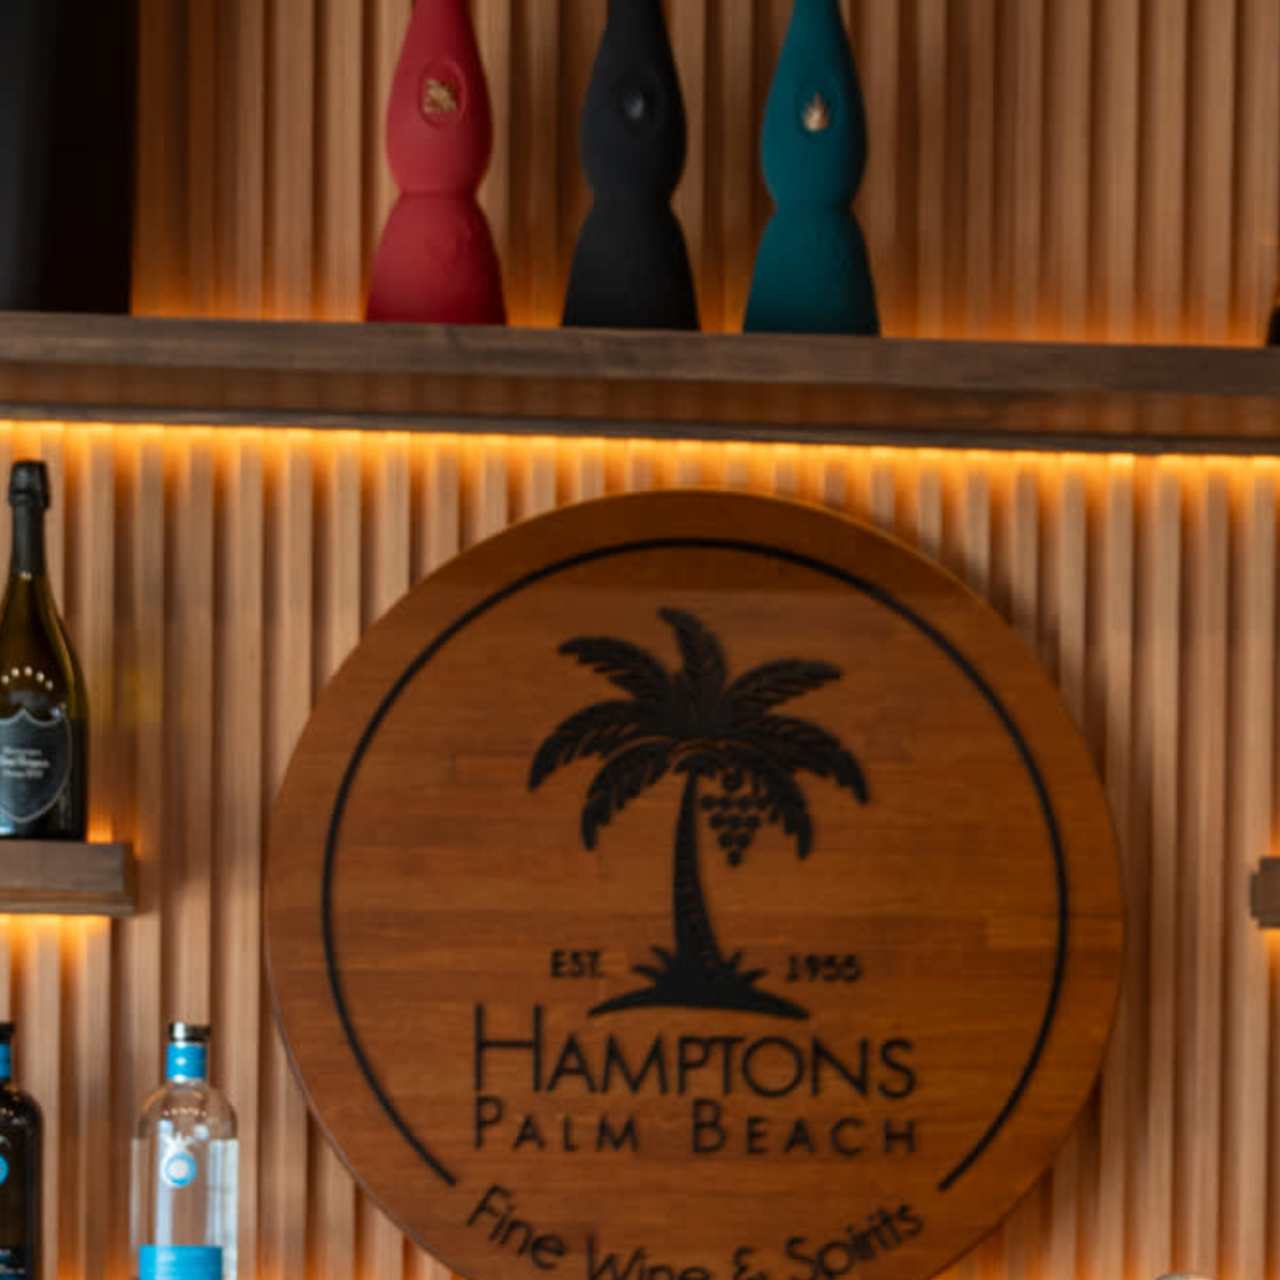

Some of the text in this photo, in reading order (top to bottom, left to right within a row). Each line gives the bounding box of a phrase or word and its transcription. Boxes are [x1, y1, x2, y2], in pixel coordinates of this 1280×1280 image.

[785, 954, 862, 983] 1955
[474, 1003, 917, 1098] HAMPTONS
[474, 1095, 917, 1155] PALM BEACH
[466, 1184, 567, 1270] Fine
